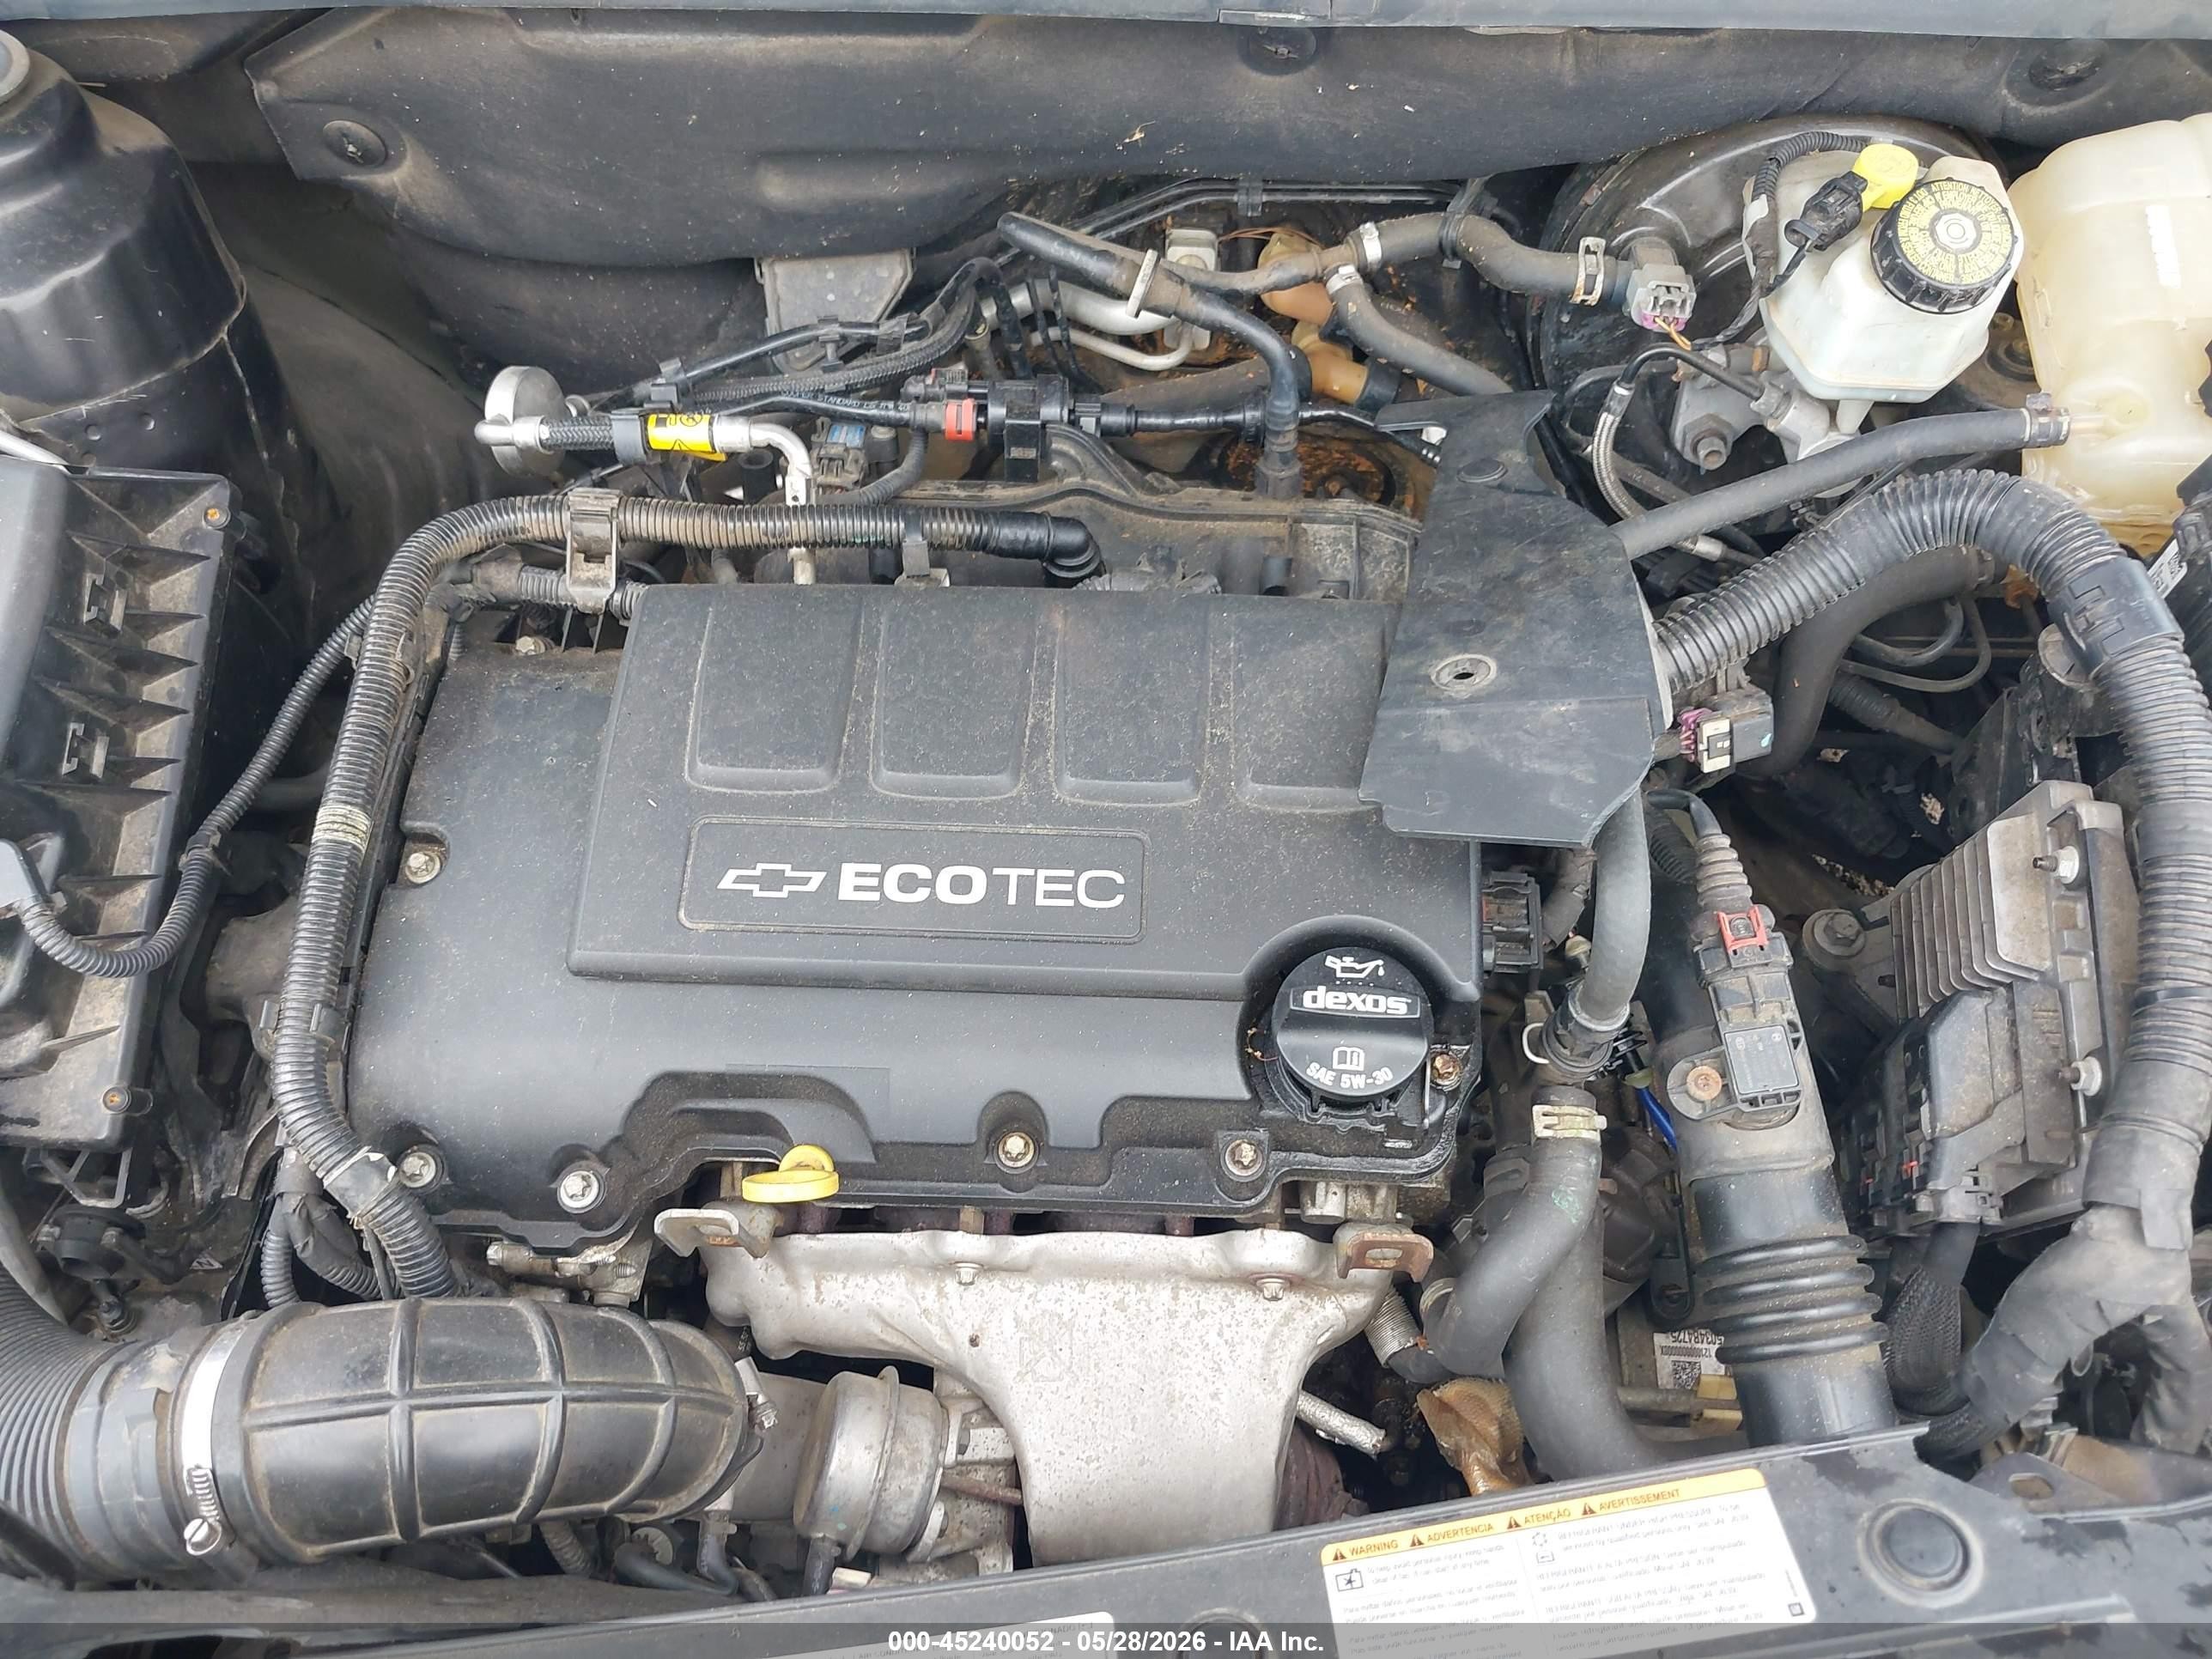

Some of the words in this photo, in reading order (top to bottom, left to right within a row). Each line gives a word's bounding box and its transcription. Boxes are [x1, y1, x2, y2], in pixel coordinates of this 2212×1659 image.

[1899, 200, 1916, 219] FLUID
[1929, 182, 1969, 192] ATTENTION
[1969, 186, 2003, 214] NETTOYER
[1897, 218, 1909, 236] FROM
[838, 862, 1125, 908] ECOTEC
[1302, 986, 1408, 1015] dexos
[1305, 1061, 1337, 1086] SAE
[1340, 1066, 1394, 1089] 5W-30
[1349, 1540, 1399, 1557] WARNING
[1426, 1523, 1494, 1544] ADVERTENCIA
[1523, 1508, 1571, 1526] ATENÇÃO
[1598, 1488, 1681, 1511] AVERTISSEMENT
